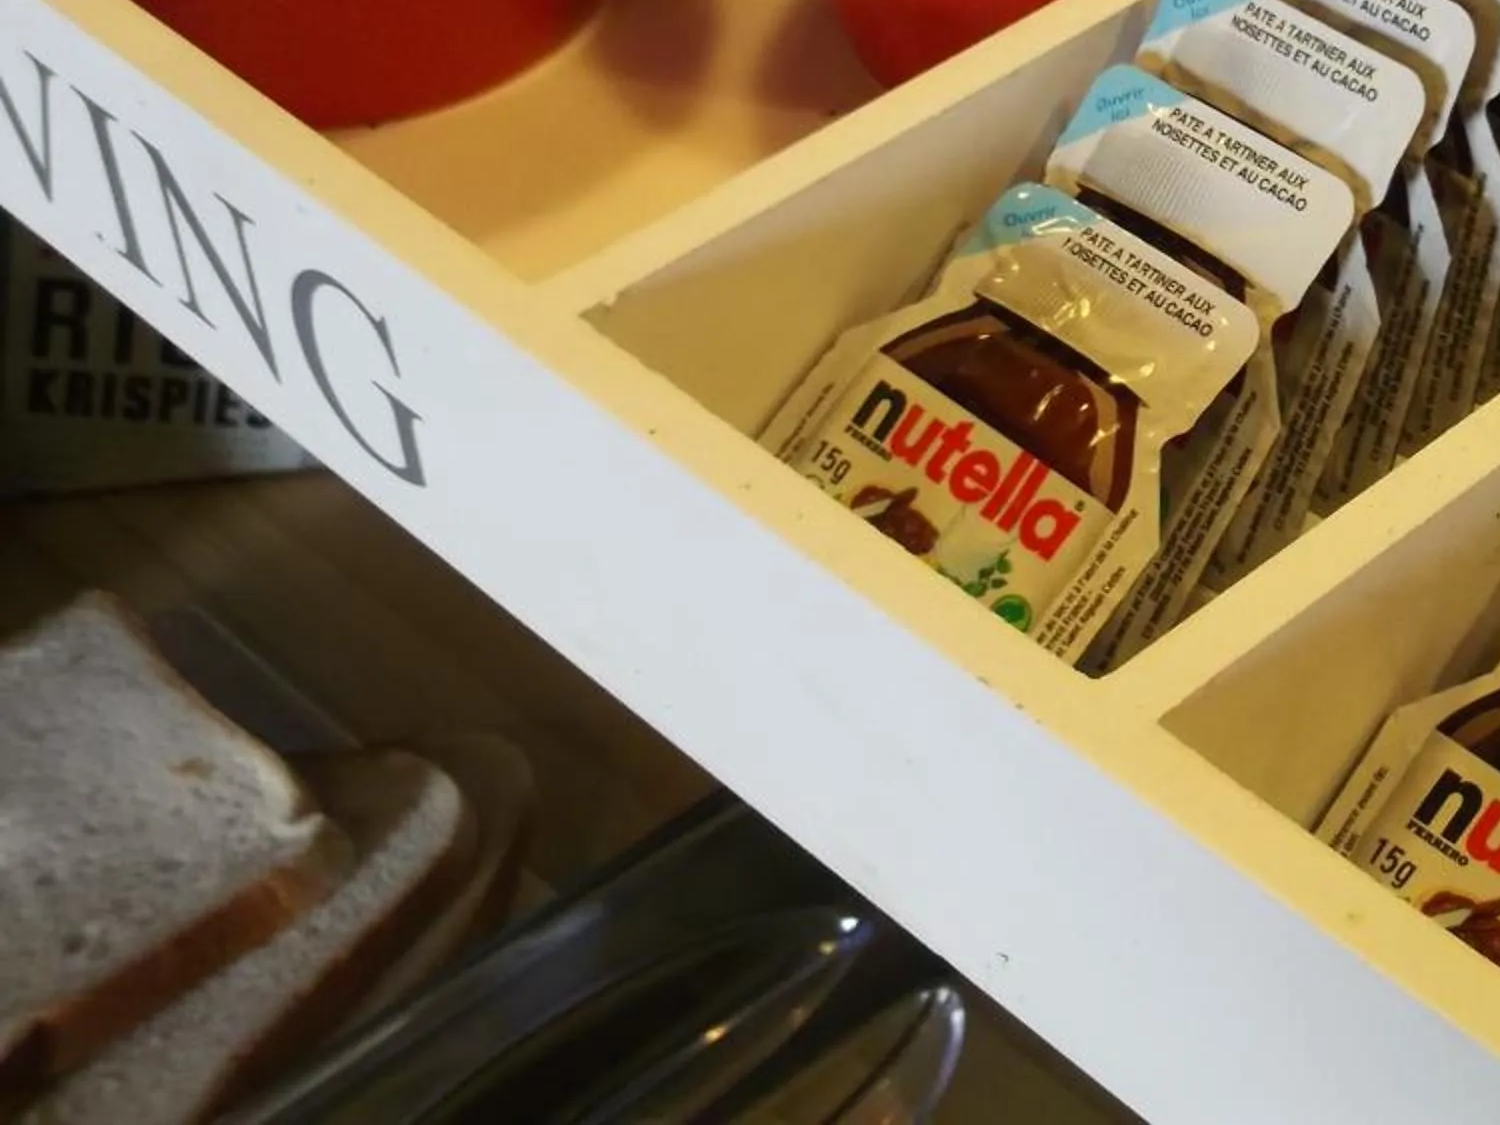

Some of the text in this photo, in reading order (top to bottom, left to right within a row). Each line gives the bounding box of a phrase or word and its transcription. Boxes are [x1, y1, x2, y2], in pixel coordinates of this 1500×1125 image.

[1231, 15, 1379, 103] NOISETTES ET AU CACAO
[1245, 3, 1378, 80] PATE A TARTINER AUX
[1381, 9, 1432, 42] CACAO
[1152, 119, 1308, 212] NOISETTES ET AU CACAO
[1169, 108, 1312, 191] PATE A TARTINER AUX
[0, 49, 428, 489] VING
[1081, 227, 1217, 316] PATE A TARTINER AUX
[1127, 278, 1146, 295] ET
[1145, 287, 1164, 309] AU
[1164, 302, 1214, 338] CACAO
[27, 368, 273, 428] KRISPIES
[811, 440, 852, 485] 15g
[851, 379, 1082, 563] nutella
[1369, 837, 1417, 889] 15g
[1406, 819, 1469, 867] FERRERO
